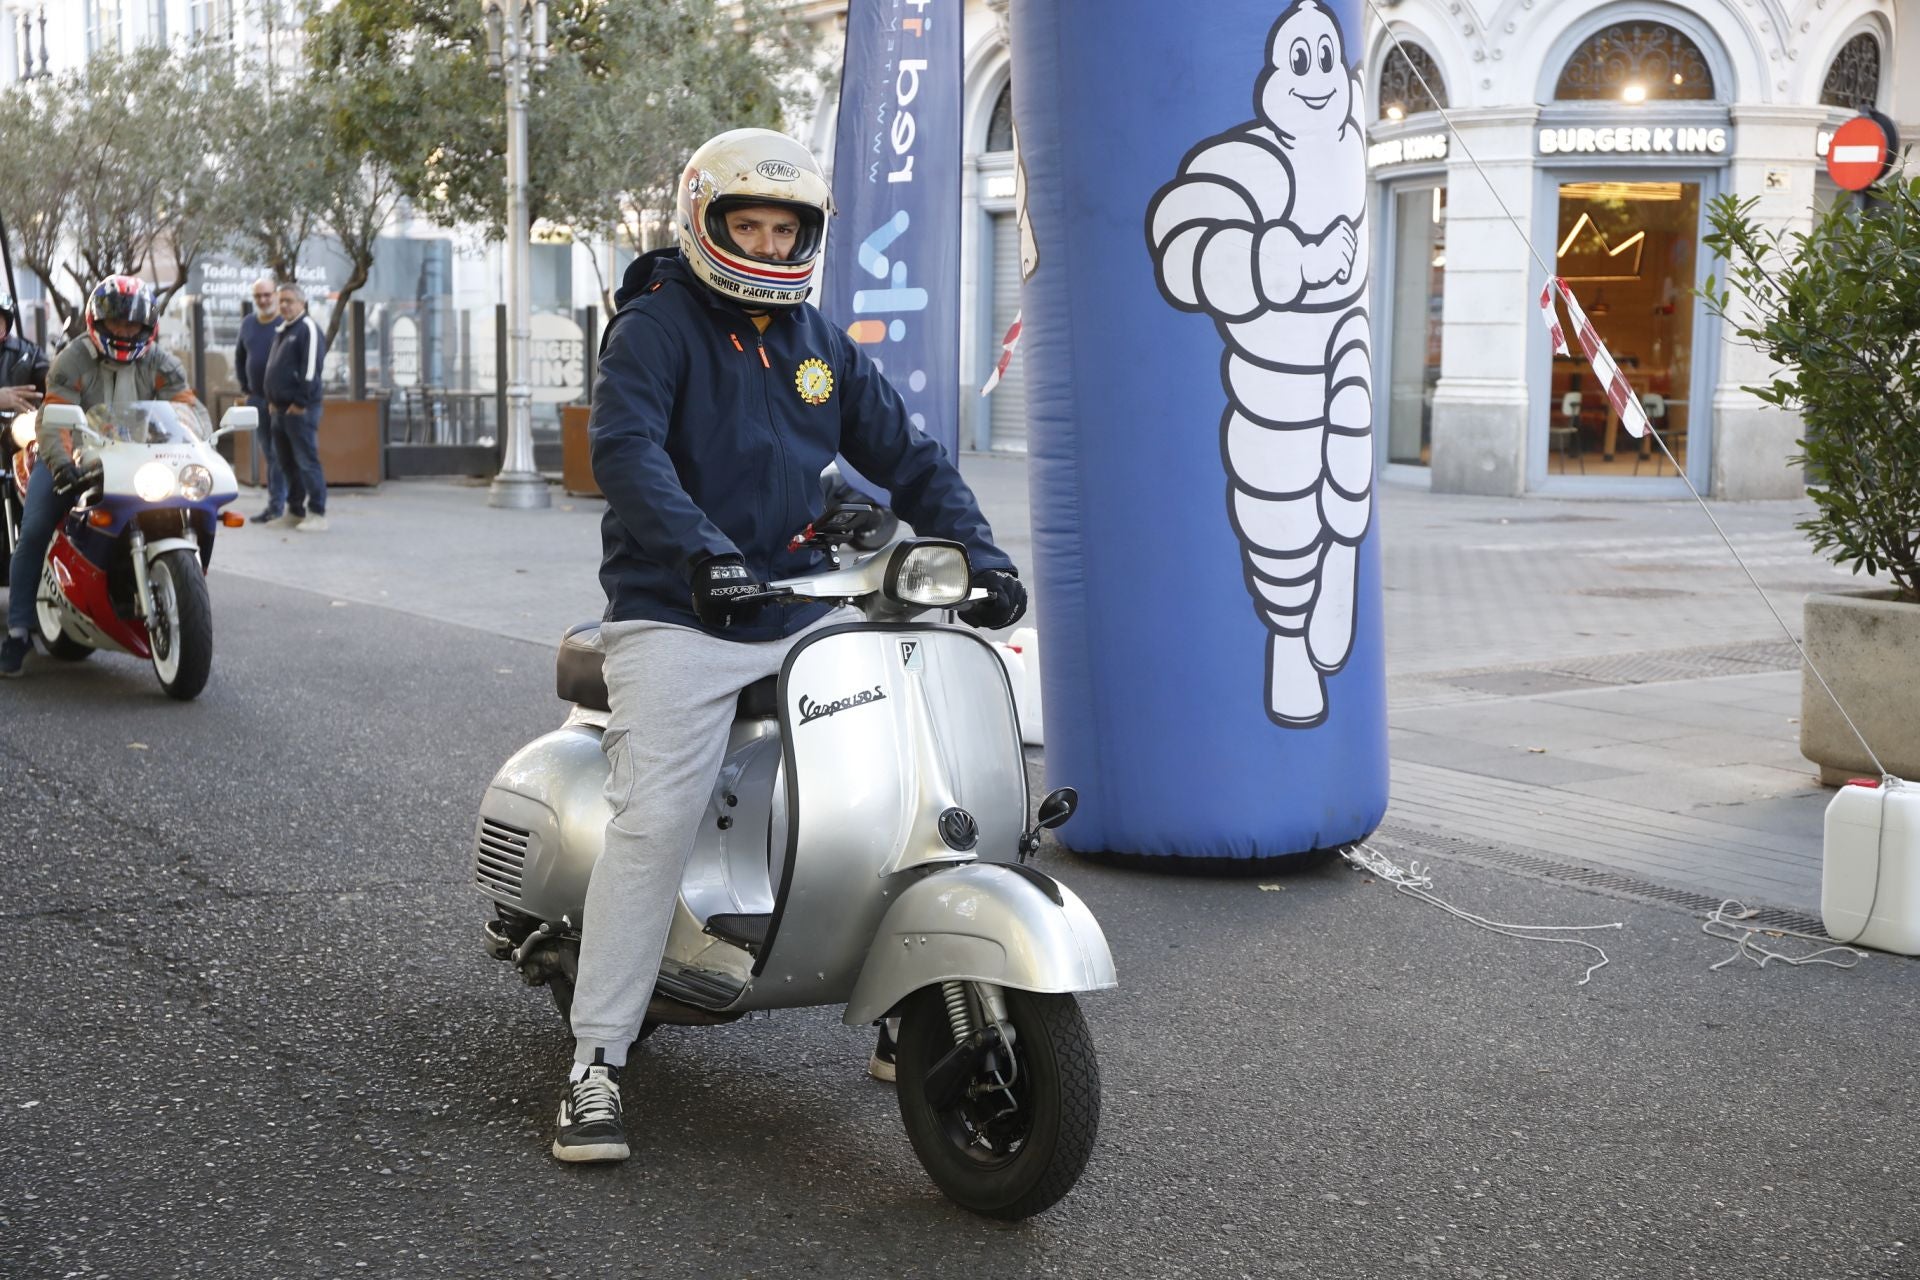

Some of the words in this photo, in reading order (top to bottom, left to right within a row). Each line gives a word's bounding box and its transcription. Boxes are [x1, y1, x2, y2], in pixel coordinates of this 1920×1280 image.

[1539, 127, 1651, 153] BURGER
[1653, 127, 1727, 152] KING
[761, 162, 796, 178] PREMIER
[709, 272, 740, 293] PREMIER
[743, 286, 774, 300] PACIFIC
